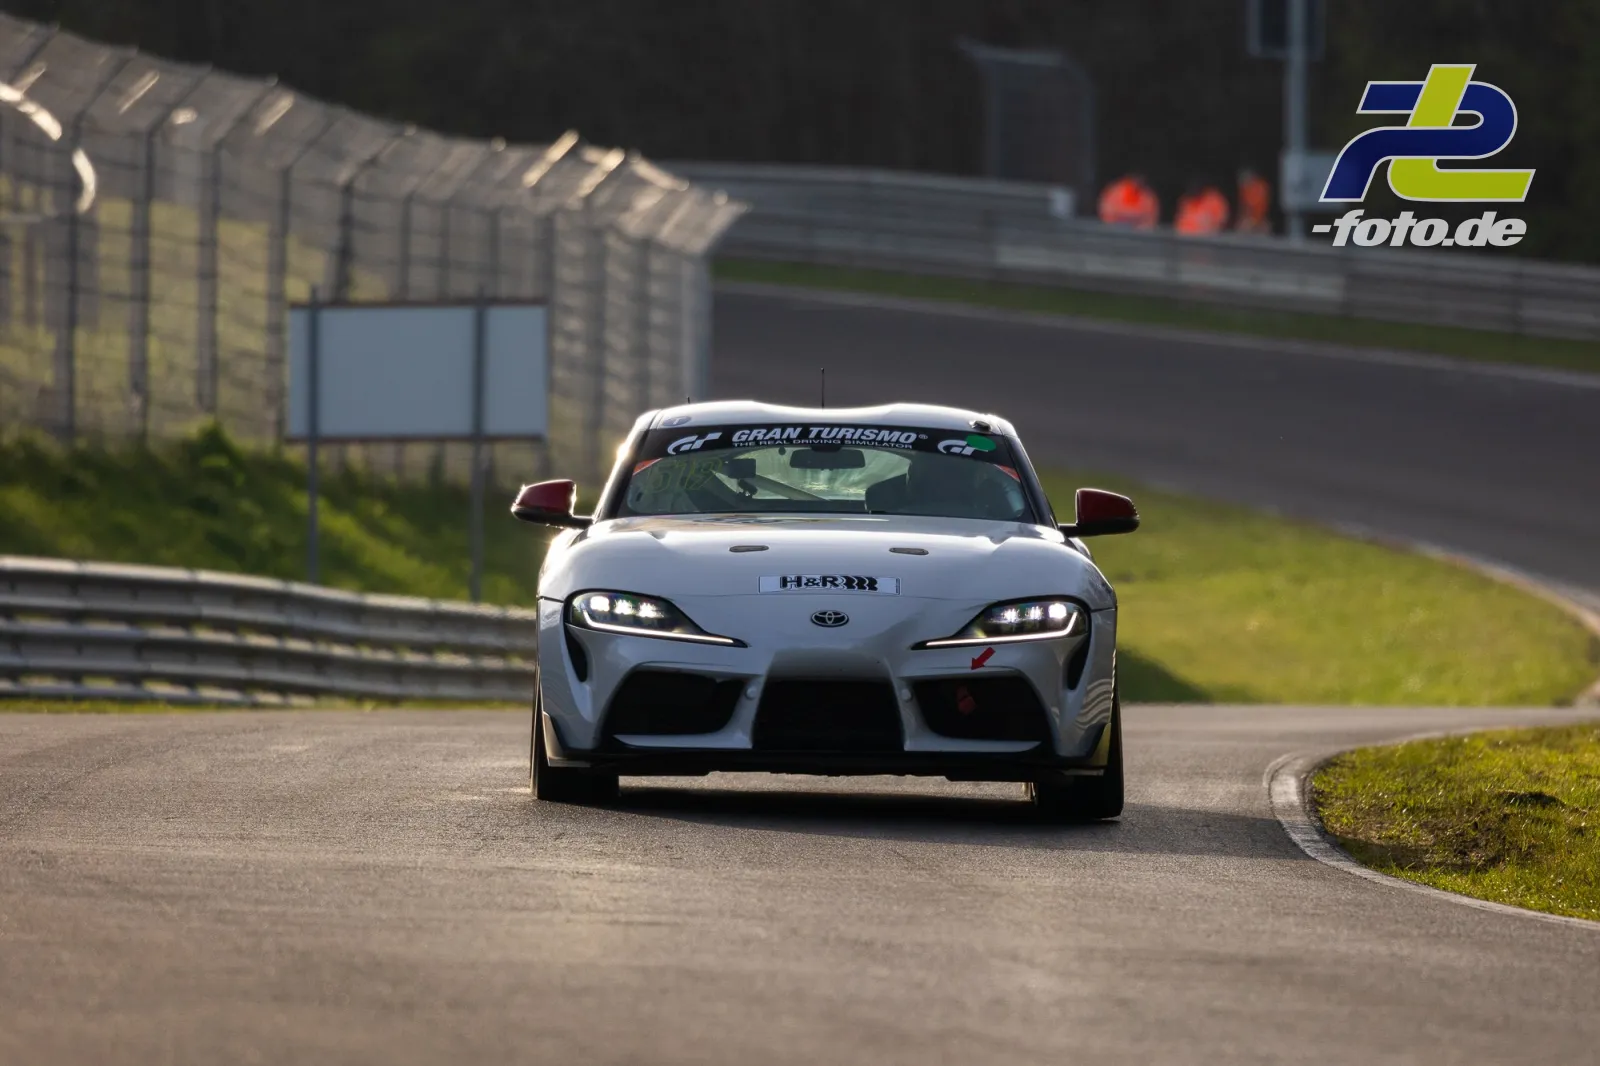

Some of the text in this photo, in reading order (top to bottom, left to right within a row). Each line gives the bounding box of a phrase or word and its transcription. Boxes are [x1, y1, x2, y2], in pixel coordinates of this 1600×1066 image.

[731, 427, 803, 443] GRAN
[844, 440, 913, 450] SIMULATOR
[780, 575, 841, 589] H&R
